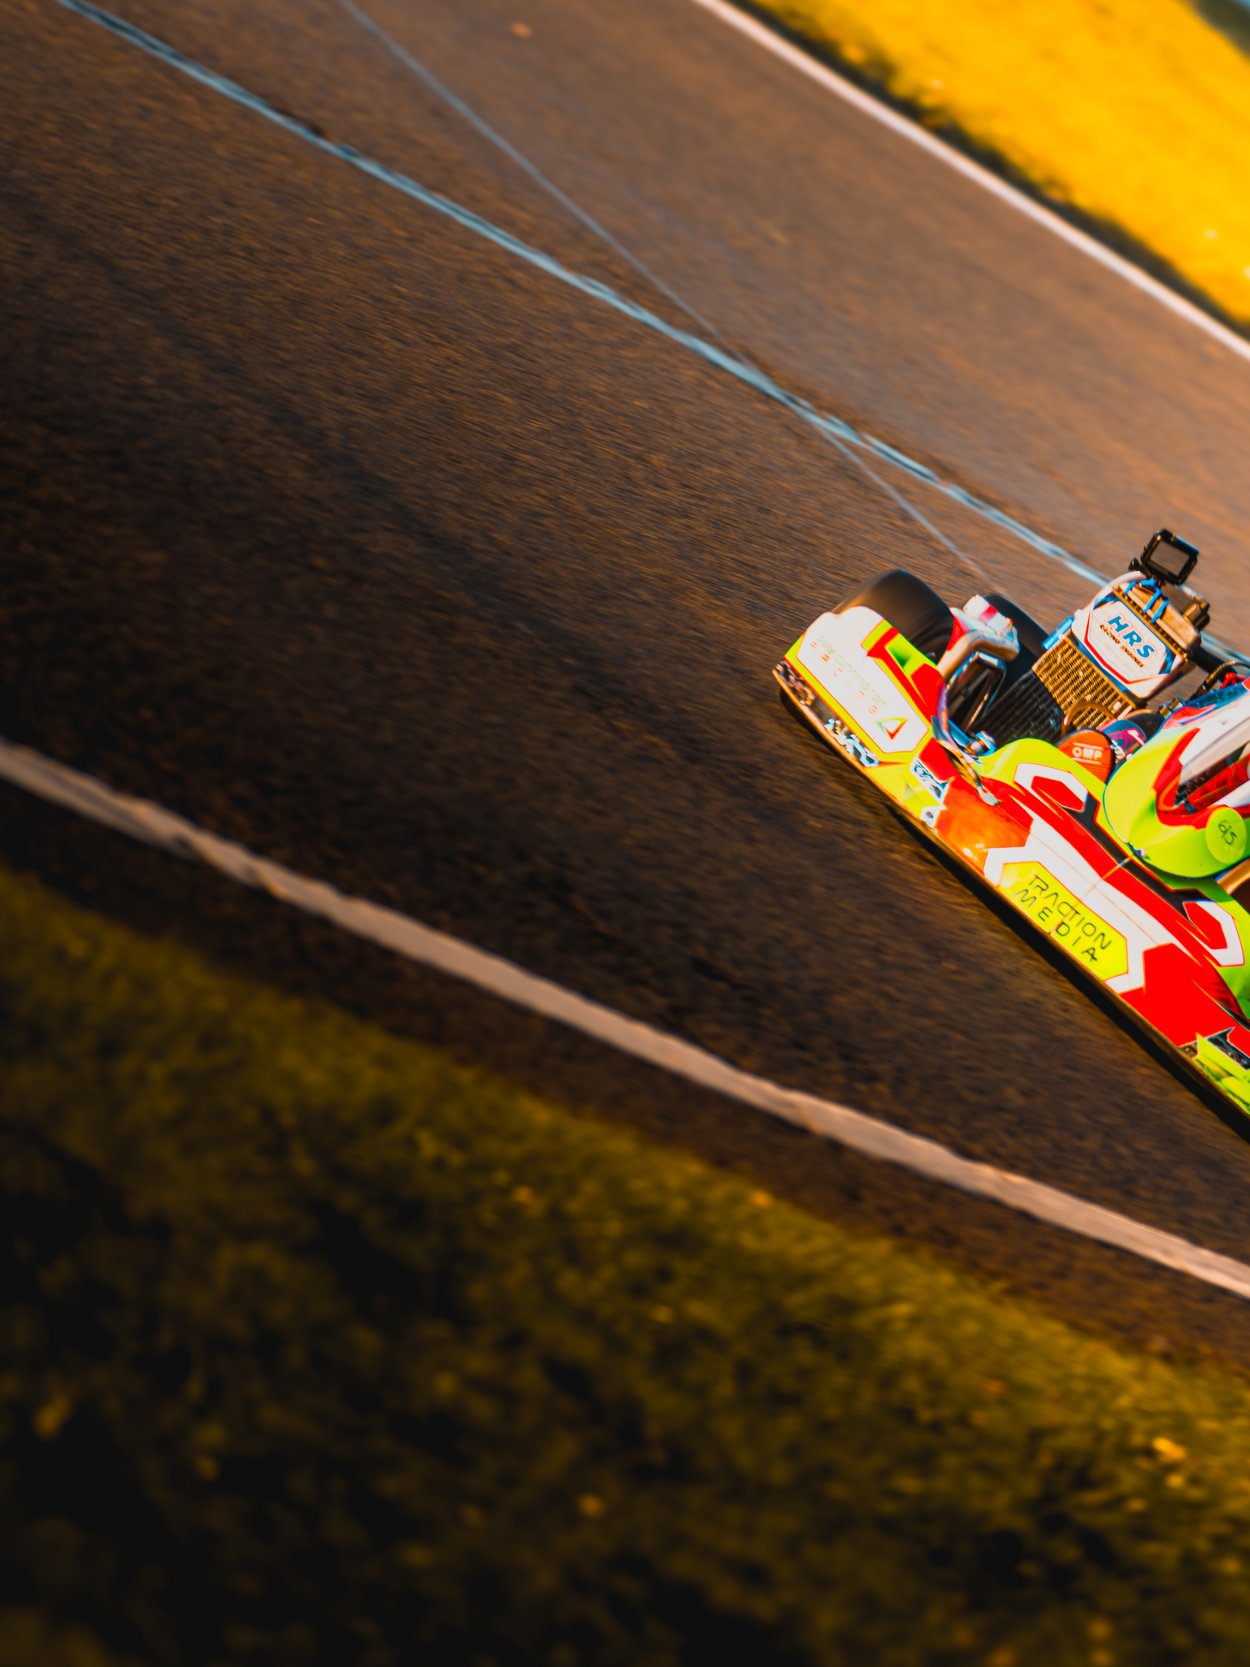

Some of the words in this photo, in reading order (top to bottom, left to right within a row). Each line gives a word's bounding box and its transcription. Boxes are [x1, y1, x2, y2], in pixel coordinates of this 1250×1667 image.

[1107, 616, 1155, 658] HRS
[1072, 746, 1103, 761] OMP
[1014, 887, 1098, 963] MEDIA
[1028, 874, 1112, 950] TRACTION
